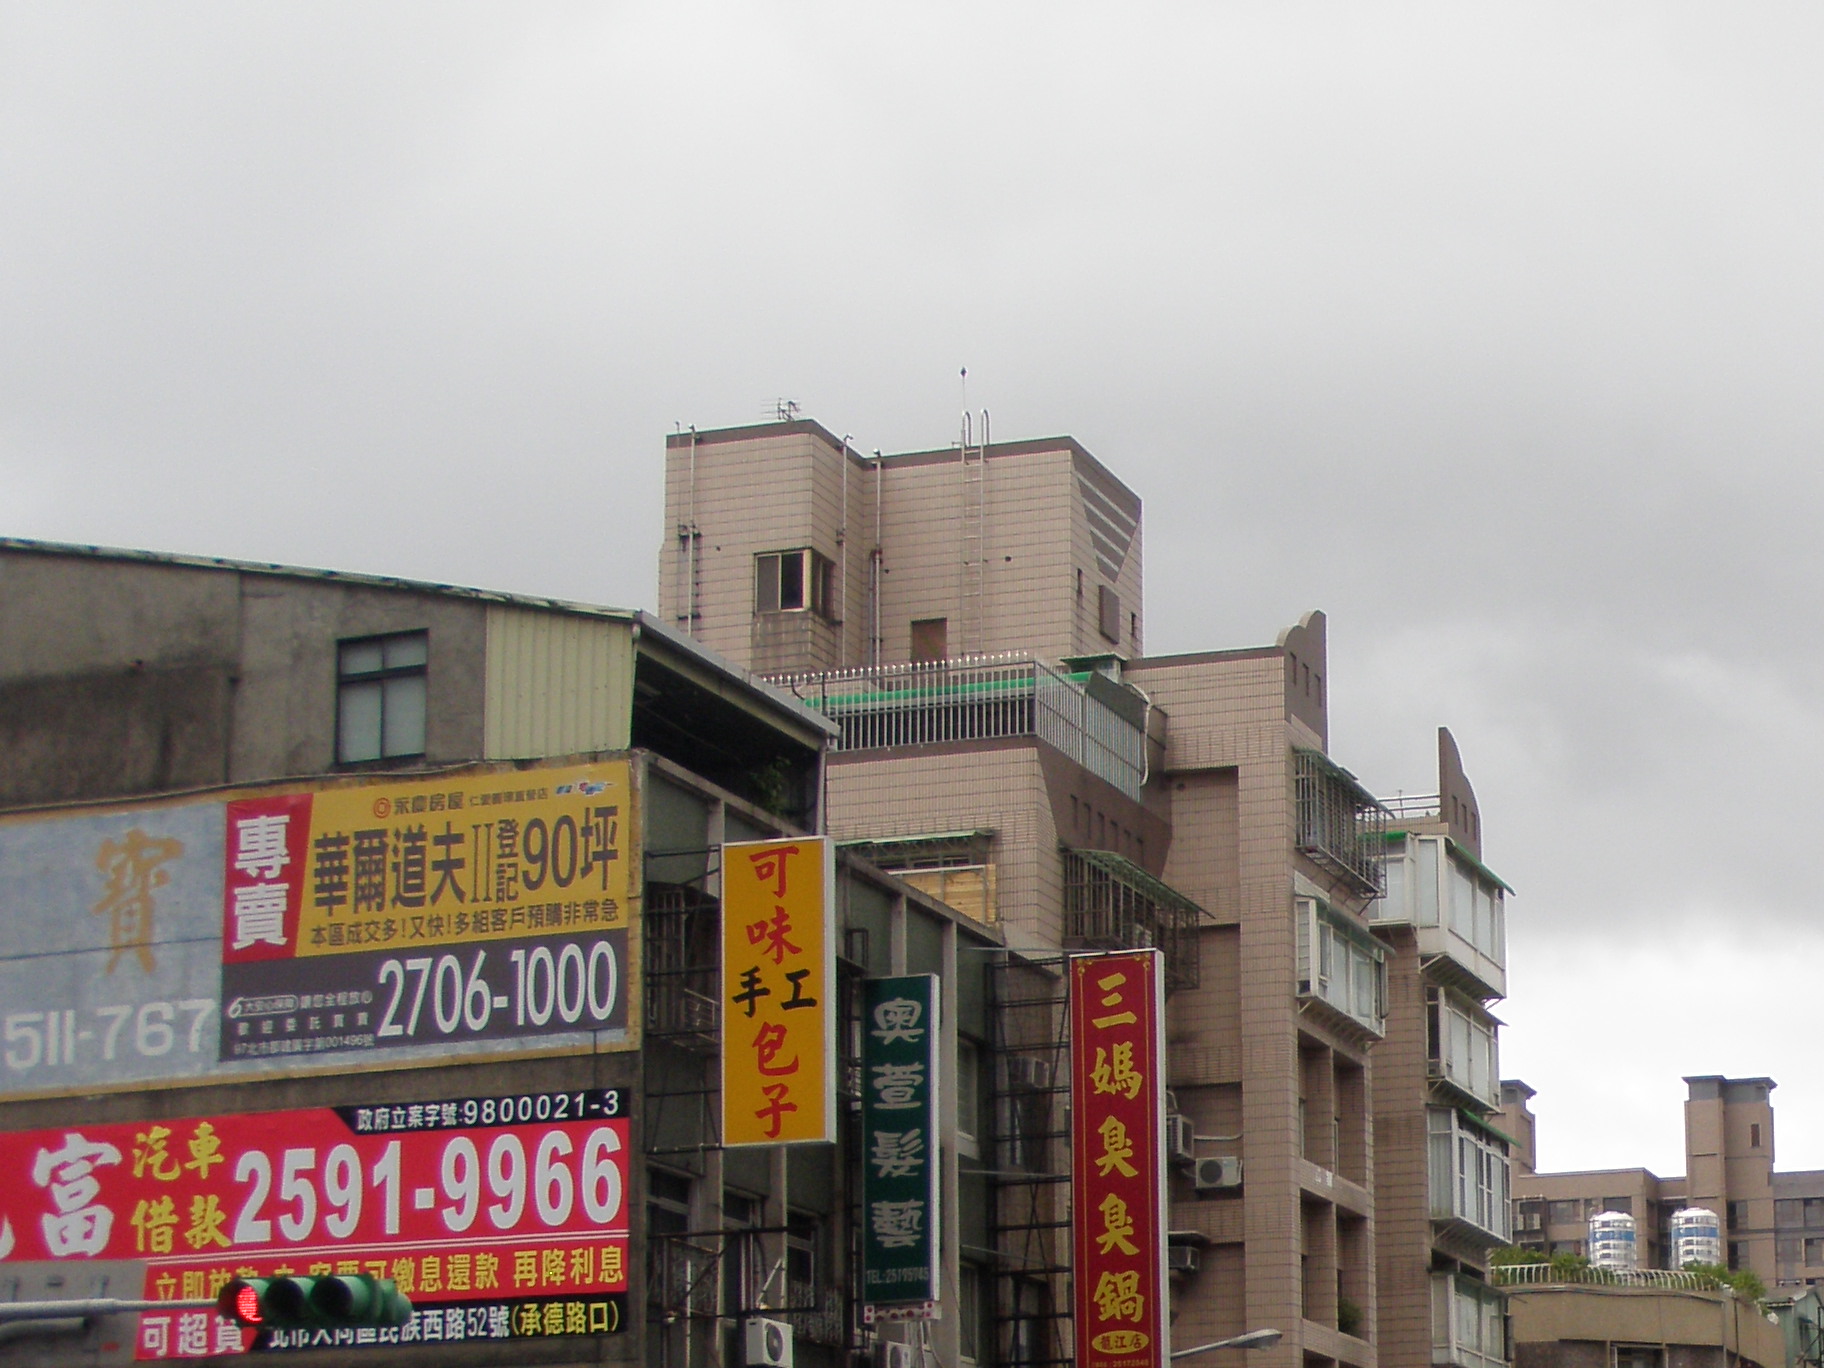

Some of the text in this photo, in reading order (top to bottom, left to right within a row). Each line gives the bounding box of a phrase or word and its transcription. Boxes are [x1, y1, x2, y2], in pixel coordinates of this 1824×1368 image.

[232, 814, 291, 951] 專賣
[377, 940, 618, 1038] 2706-1000
[131, 1121, 225, 1181] 汽車
[233, 1126, 623, 1245] 2591-9966
[1088, 970, 1146, 1325] 三媽臭臭鍋
[130, 1194, 234, 1255] 借款
[513, 1245, 625, 1289] 再降利息
